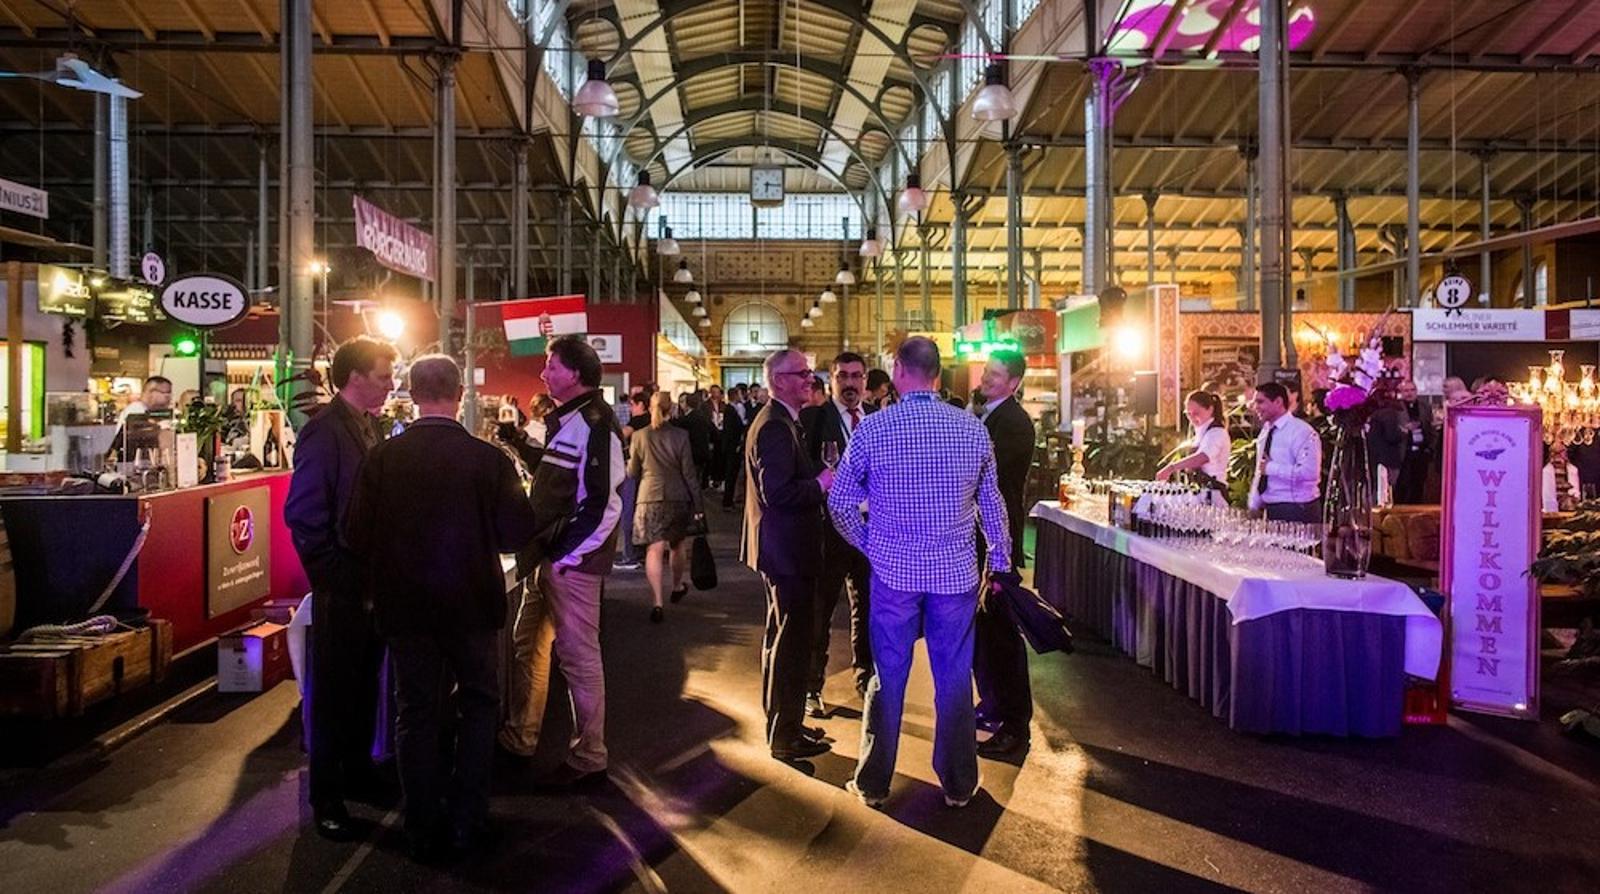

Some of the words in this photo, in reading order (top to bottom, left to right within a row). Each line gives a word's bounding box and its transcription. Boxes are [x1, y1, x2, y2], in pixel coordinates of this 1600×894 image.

[173, 291, 232, 310] KASSE
[1448, 288, 1459, 304] 8
[1426, 322, 1481, 331] SCHLEMMER
[1482, 320, 1518, 331] VARIETÉ
[1476, 469, 1506, 677] WILLKOMMEN
